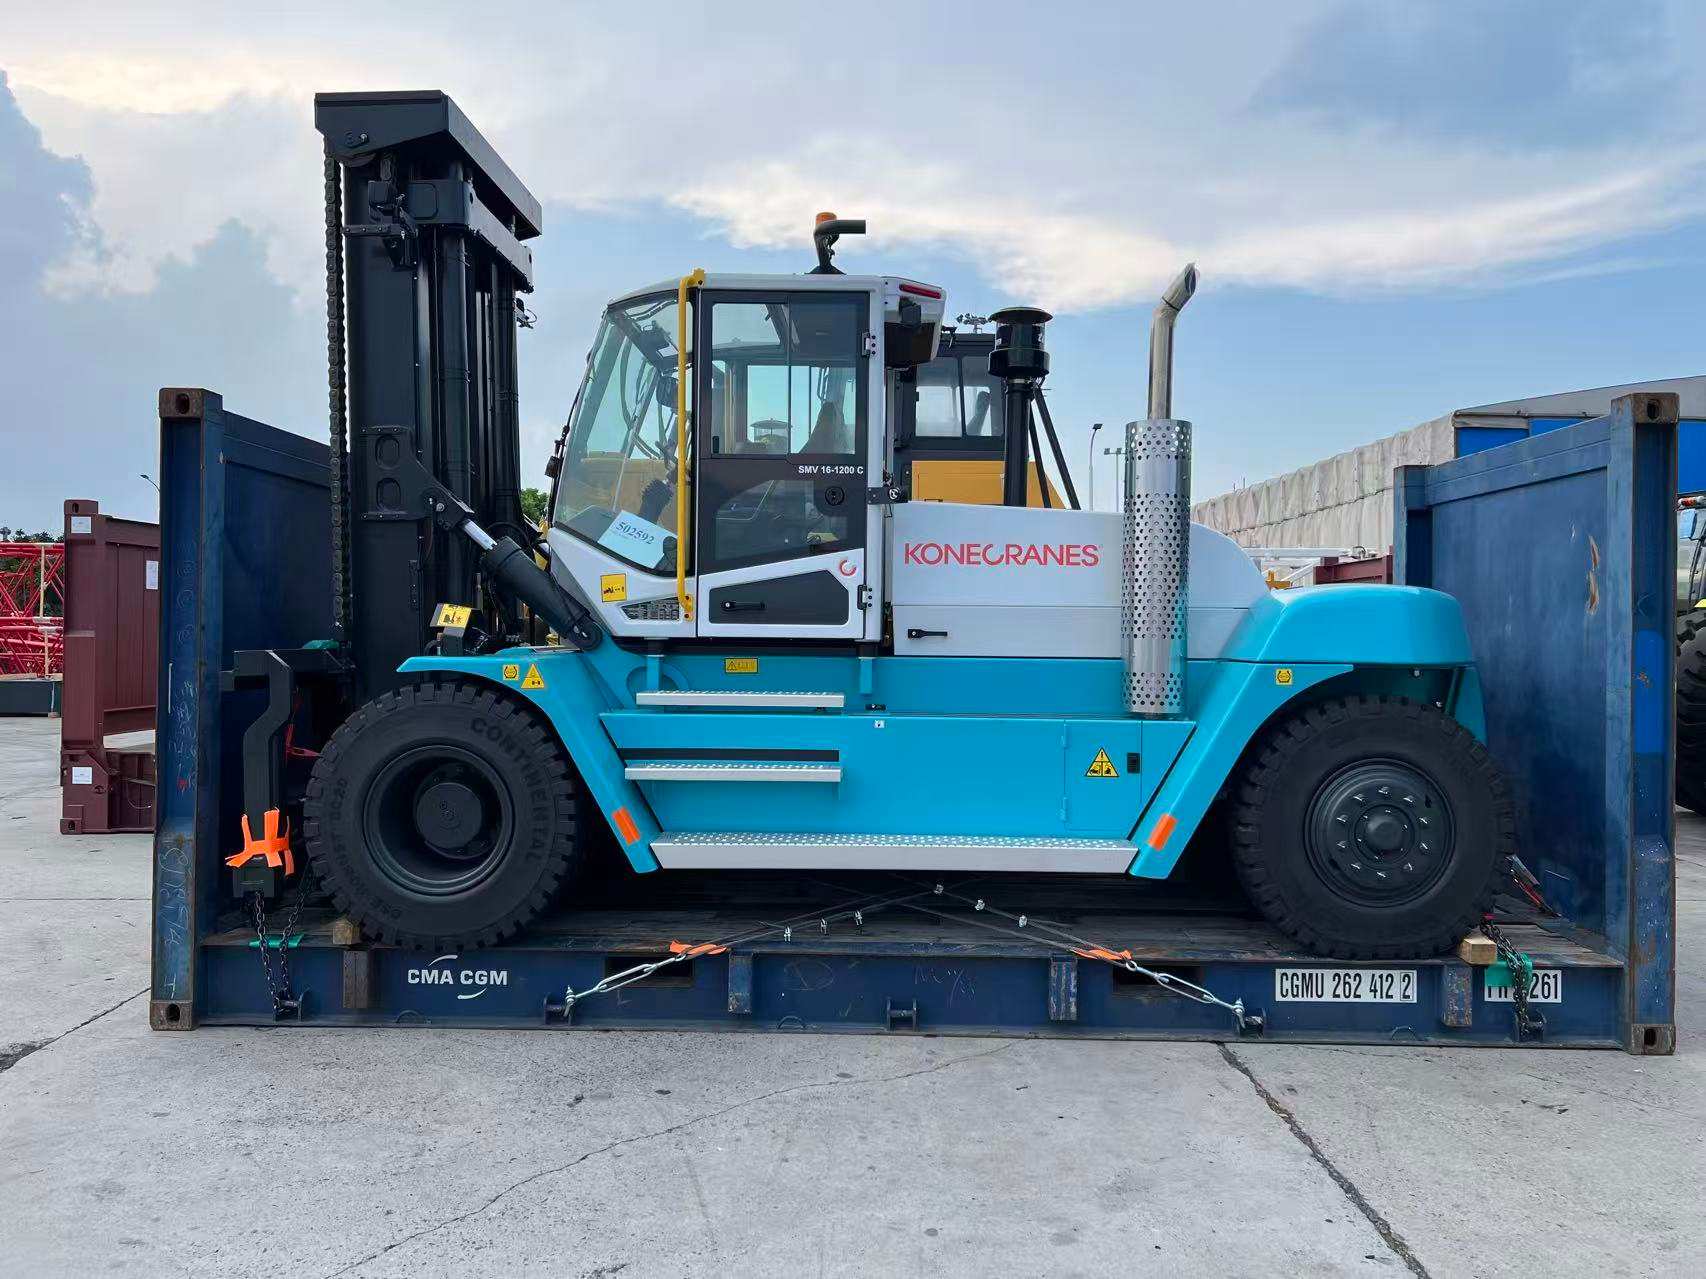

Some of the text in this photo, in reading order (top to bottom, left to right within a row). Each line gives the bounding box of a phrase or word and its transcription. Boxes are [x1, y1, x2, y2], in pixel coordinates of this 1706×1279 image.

[798, 465, 864, 475] SMV 16-1200 C
[615, 520, 656, 545] 502592
[904, 542, 1099, 567] KONECRANES
[407, 969, 508, 986] CMA CGM
[1279, 972, 1411, 999] CGMU 262 412 2
